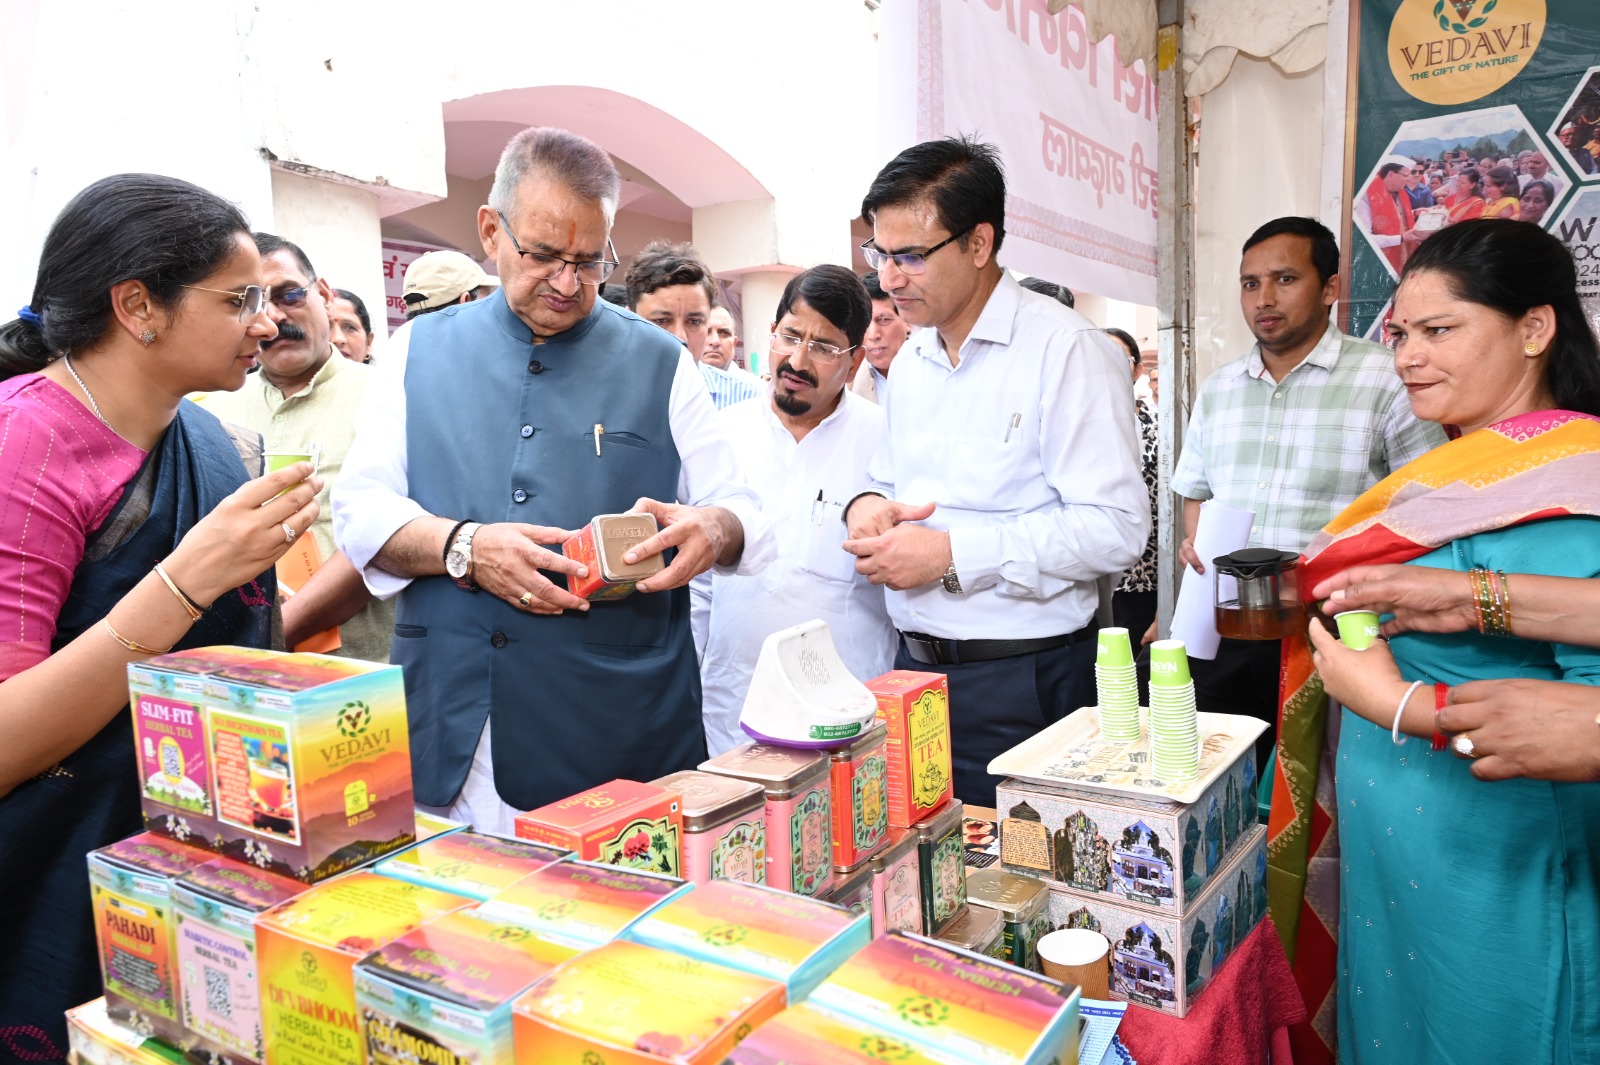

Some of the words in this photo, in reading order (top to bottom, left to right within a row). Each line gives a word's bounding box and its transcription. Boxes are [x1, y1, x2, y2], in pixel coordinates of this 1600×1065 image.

[1400, 22, 1532, 71] VEDAVI
[1410, 71, 1429, 82] THE
[1431, 65, 1454, 78] GIFT
[1458, 62, 1473, 74] OF
[1475, 54, 1519, 70] NATURE
[383, 255, 398, 279] वं
[1576, 279, 1600, 287] cess
[386, 296, 408, 314] गढ़
[141, 701, 193, 725] SLIM-FIT
[918, 711, 940, 728] VEDAVI
[145, 719, 175, 735] HERBAL
[177, 727, 193, 739] TEA
[320, 728, 391, 763] VEDAVI
[918, 738, 943, 763] TEA
[347, 816, 359, 827] 10
[313, 866, 326, 879] The
[328, 859, 343, 875] Real
[345, 853, 364, 868] Taste
[365, 848, 374, 860] of
[892, 900, 914, 921] TEA
[105, 910, 156, 945] PAHADI
[912, 954, 944, 971] TEA
[953, 966, 1021, 997] HERBAL
[279, 1012, 327, 1042] HERBAL
[329, 1030, 354, 1053] TEA
